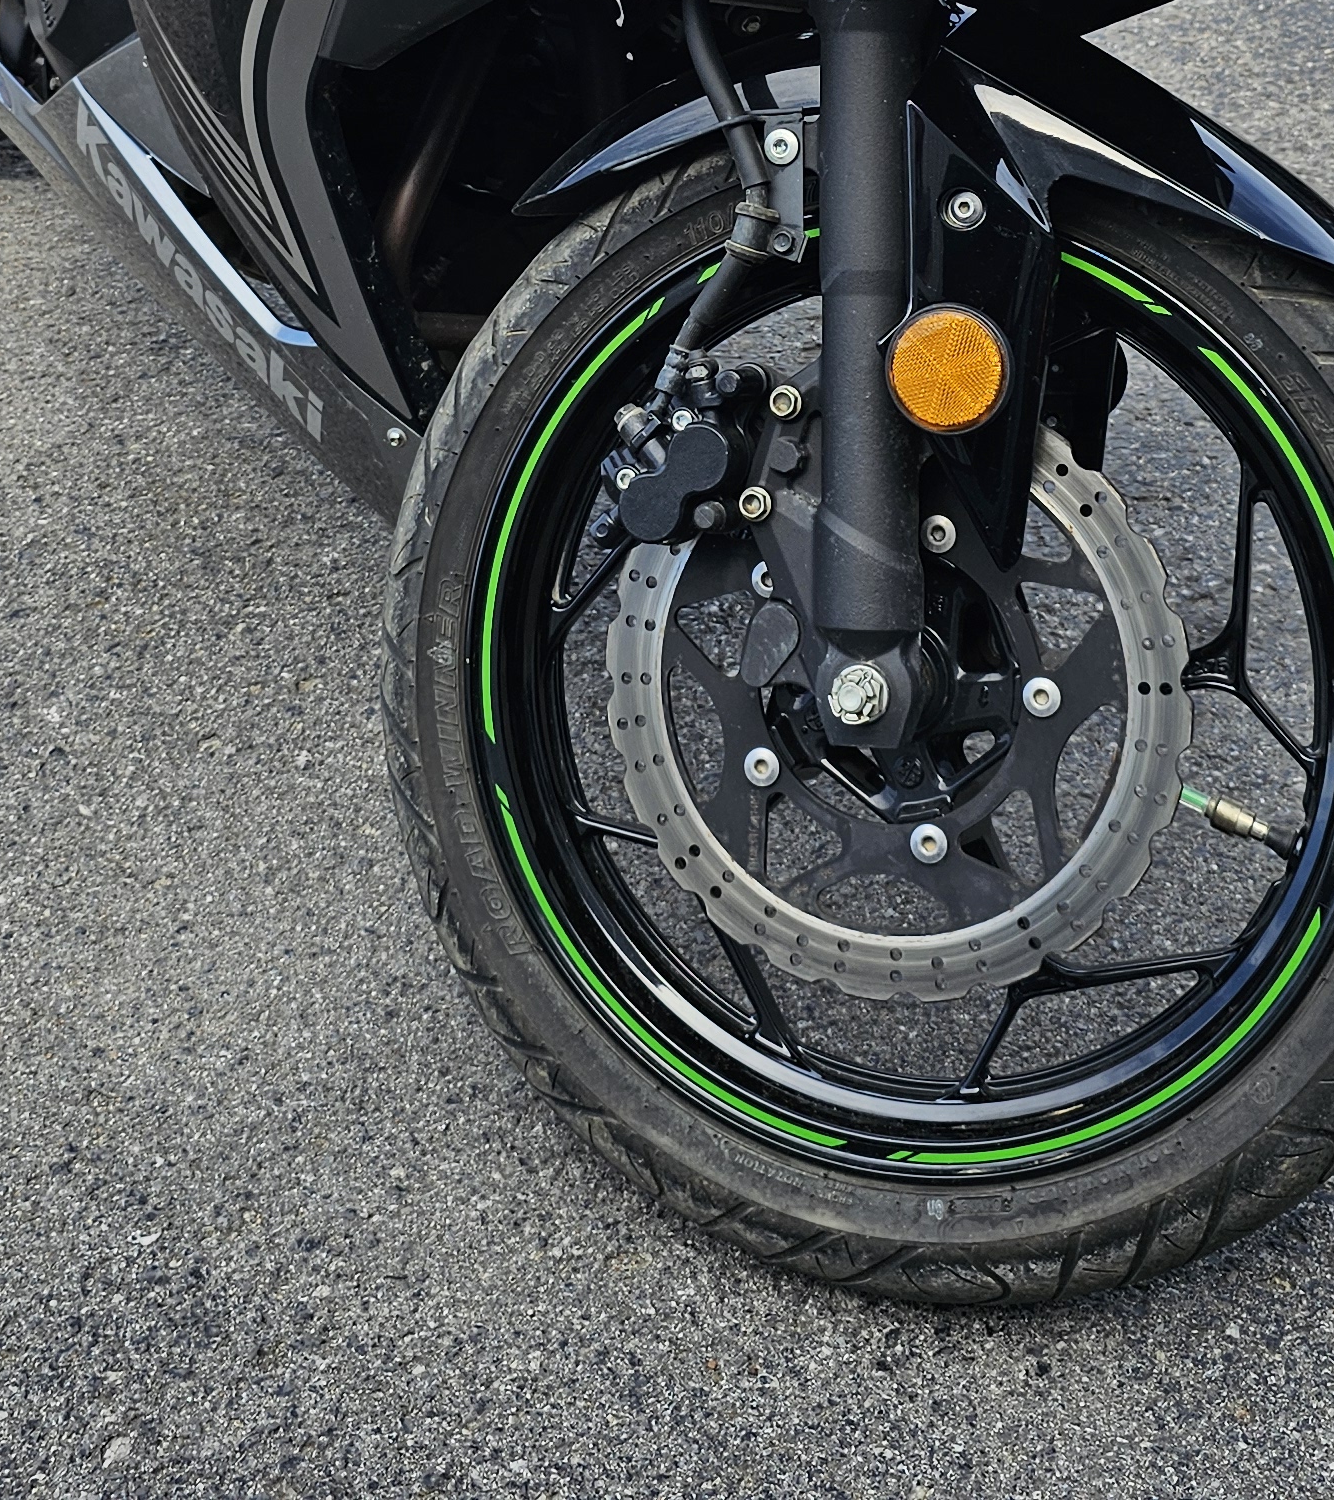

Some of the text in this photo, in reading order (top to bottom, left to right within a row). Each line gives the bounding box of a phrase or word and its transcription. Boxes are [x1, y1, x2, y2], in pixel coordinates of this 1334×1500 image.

[76, 96, 324, 443] Kawasaki
[683, 203, 736, 246] 110/
[435, 576, 533, 957] ROAD WINNER
[733, 1152, 804, 1189] ROTATION
